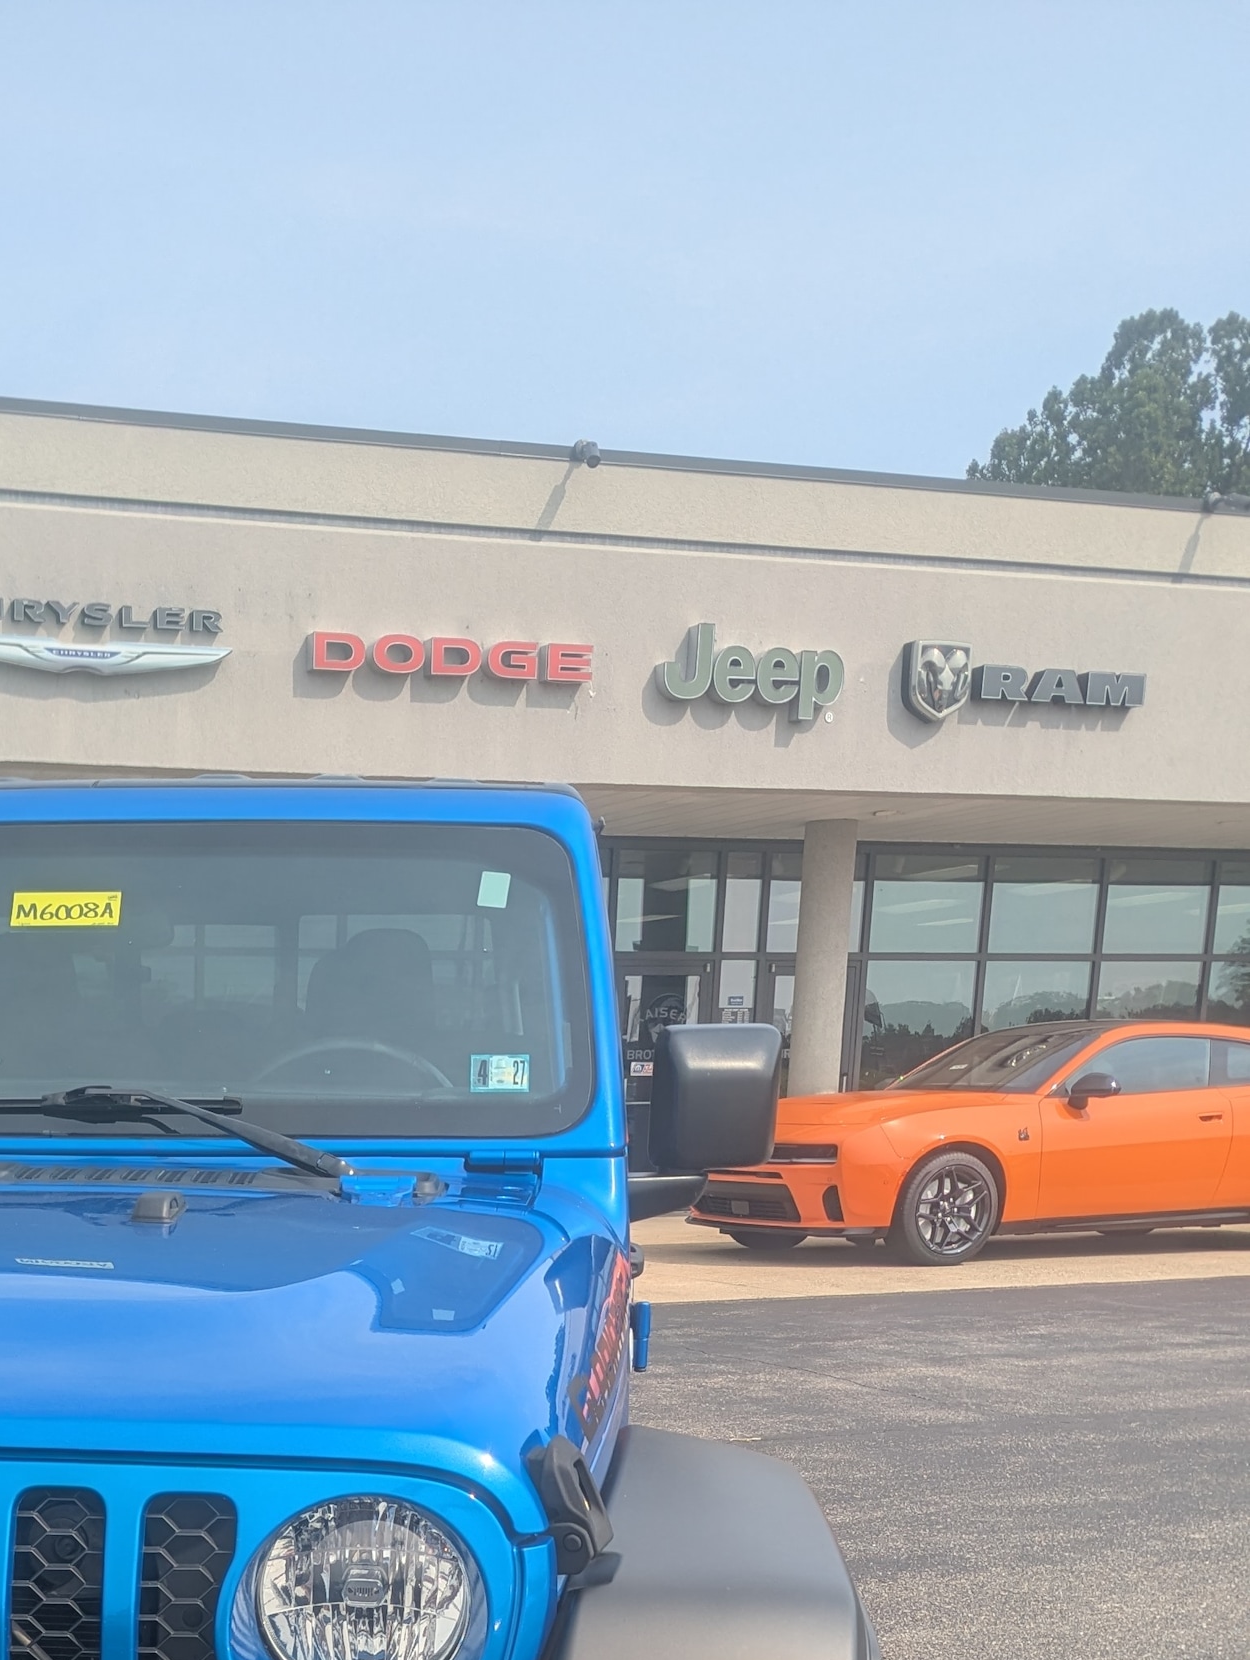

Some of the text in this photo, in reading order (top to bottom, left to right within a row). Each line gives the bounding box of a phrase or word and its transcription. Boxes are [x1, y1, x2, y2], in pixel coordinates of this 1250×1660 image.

[52, 649, 111, 658] CHRYSLER
[310, 631, 594, 682] DODGE
[659, 623, 845, 720] Jeep
[980, 664, 1147, 706] RAM
[16, 902, 114, 921] M6008A
[513, 1060, 526, 1087] 27
